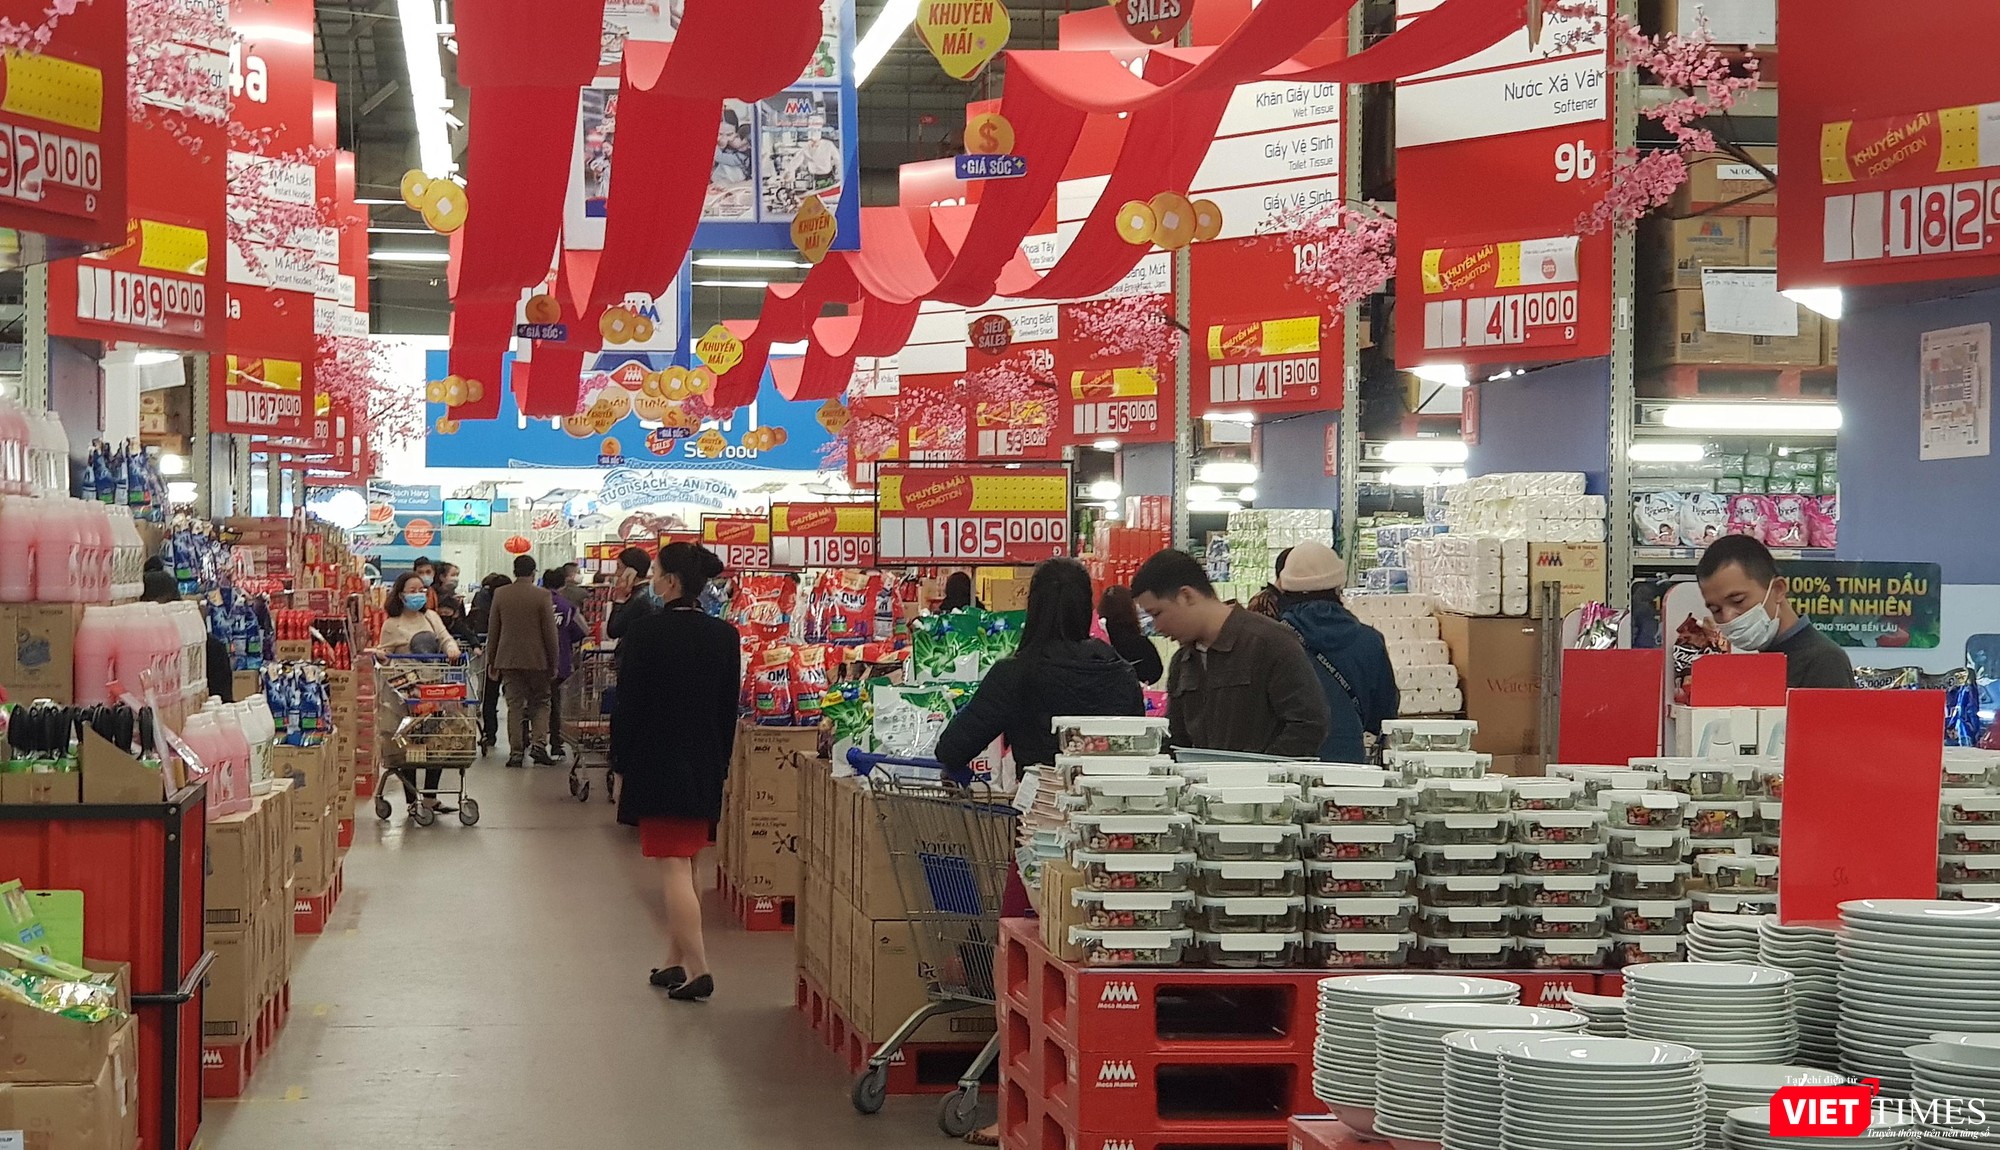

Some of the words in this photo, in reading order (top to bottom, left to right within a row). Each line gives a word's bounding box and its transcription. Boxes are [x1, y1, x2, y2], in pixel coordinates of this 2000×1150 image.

[1126, 0, 1181, 24] SALES
[941, 28, 973, 55] MÃI
[1504, 79, 1543, 101] Nước
[1548, 73, 1569, 94] Xả
[1293, 108, 1308, 118] Wet
[1311, 104, 1334, 116] Tissue
[1553, 97, 1598, 114] Softener
[1264, 140, 1288, 160] Giấy
[1310, 135, 1334, 152] Sinh
[1853, 127, 1904, 166] KHUYẾN
[1906, 112, 1931, 137] MÃI
[966, 157, 986, 175] GIÁ
[989, 153, 1012, 175] SỐC
[1288, 160, 1307, 171] Toilet
[1310, 156, 1334, 168] Tissue
[1554, 139, 1597, 183] 9b
[1868, 136, 1928, 178] PROMOTION
[1309, 188, 1333, 205] Sinh
[798, 212, 830, 234] KHUYẾN
[1477, 244, 1494, 262] MÃI
[1452, 261, 1491, 291] PROMOTION
[983, 318, 1005, 335] SIÊU
[978, 333, 1008, 349] SALES
[905, 479, 946, 505] KHUYẾN
[946, 474, 966, 491] MÃI
[916, 489, 963, 511] PROMOTION
[1786, 576, 1832, 595] 100%
[1836, 577, 1881, 595] TINH
[1788, 593, 1844, 616] THIÊN
[1849, 595, 1912, 617] NHIÊN
